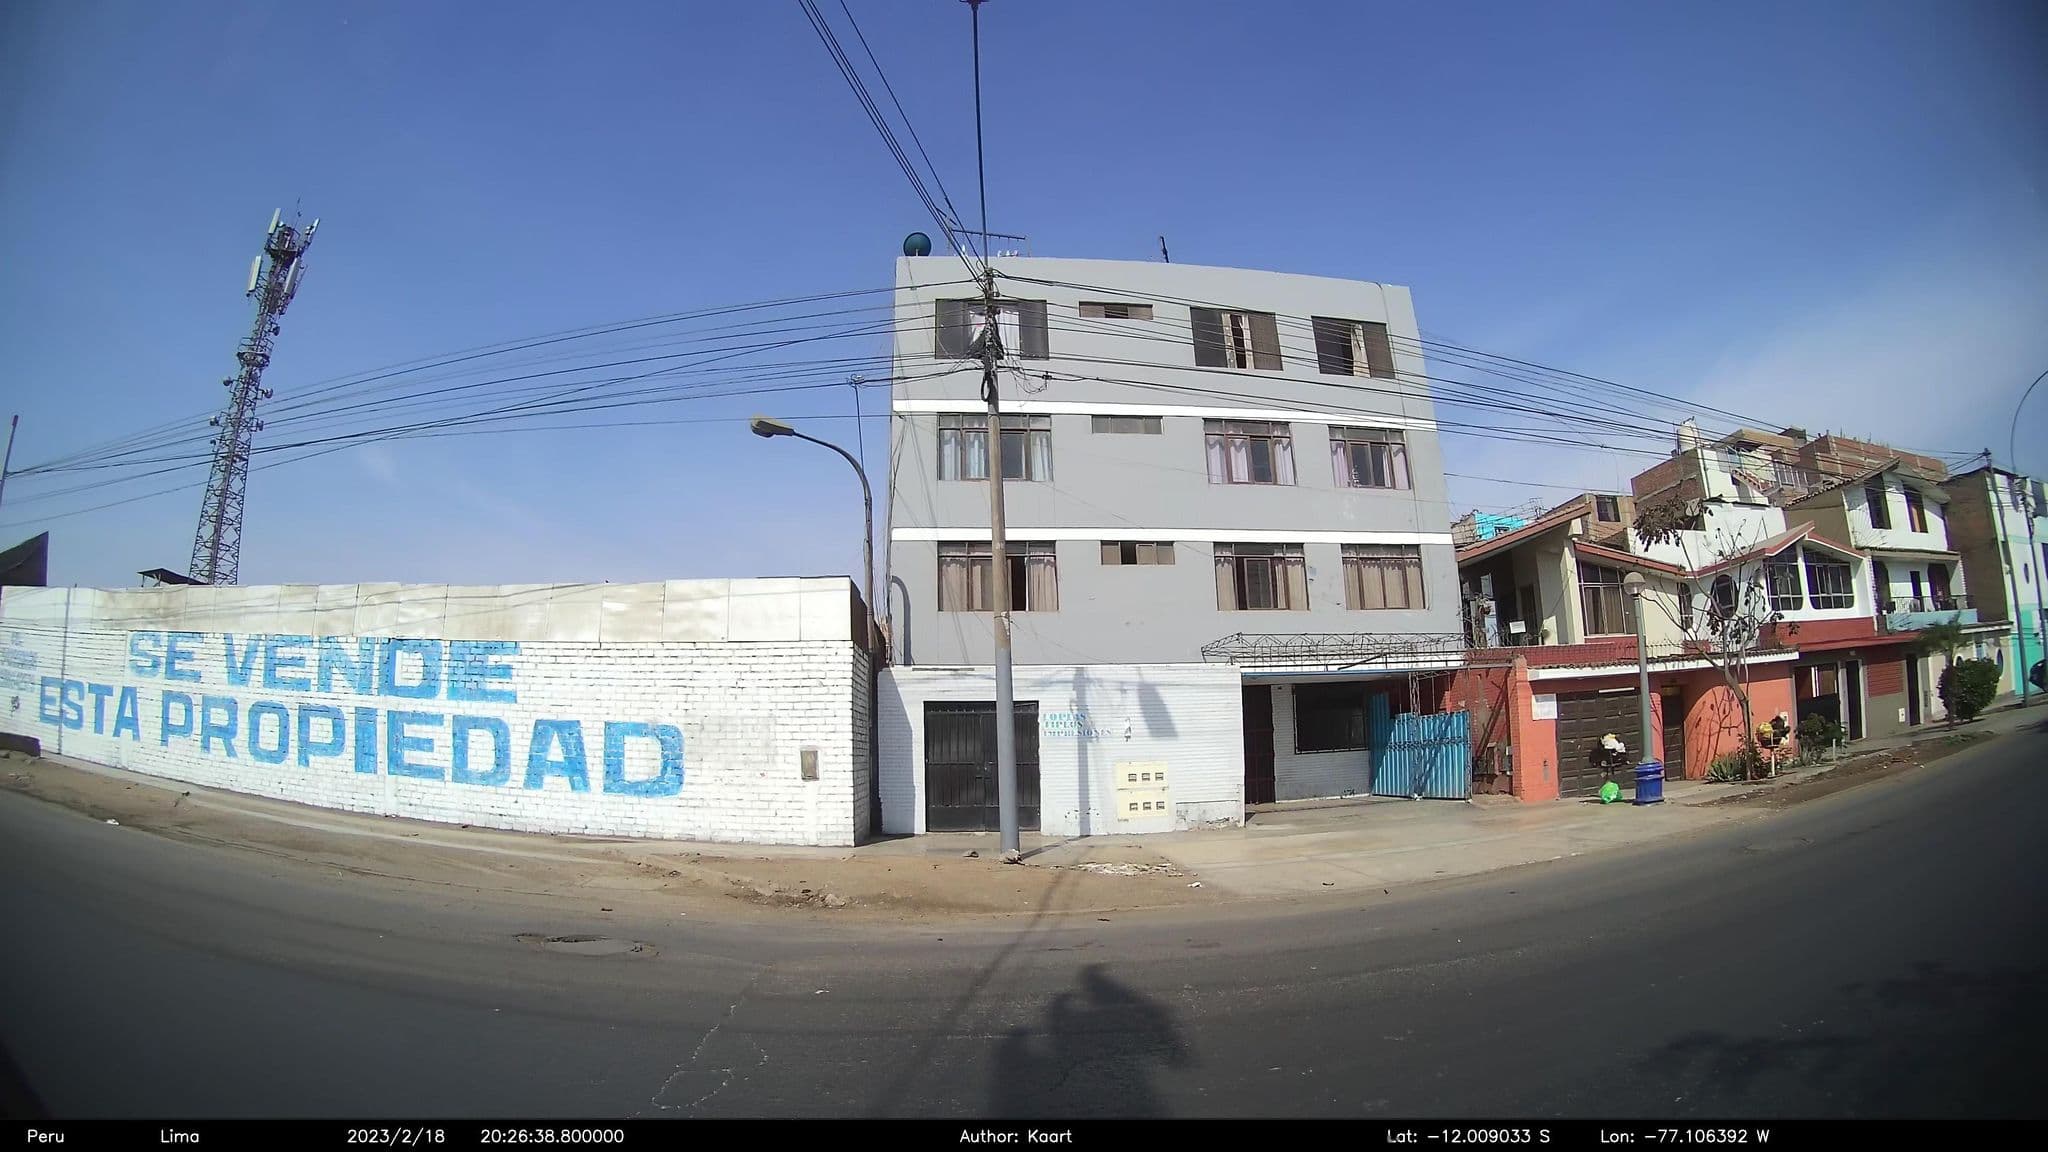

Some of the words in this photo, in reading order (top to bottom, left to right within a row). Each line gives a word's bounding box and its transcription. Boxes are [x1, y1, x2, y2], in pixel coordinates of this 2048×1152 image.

[129, 630, 204, 683] SE
[223, 633, 519, 704] VENDE
[39, 675, 141, 742] ESTA
[161, 690, 686, 797] PROPIEDAD
